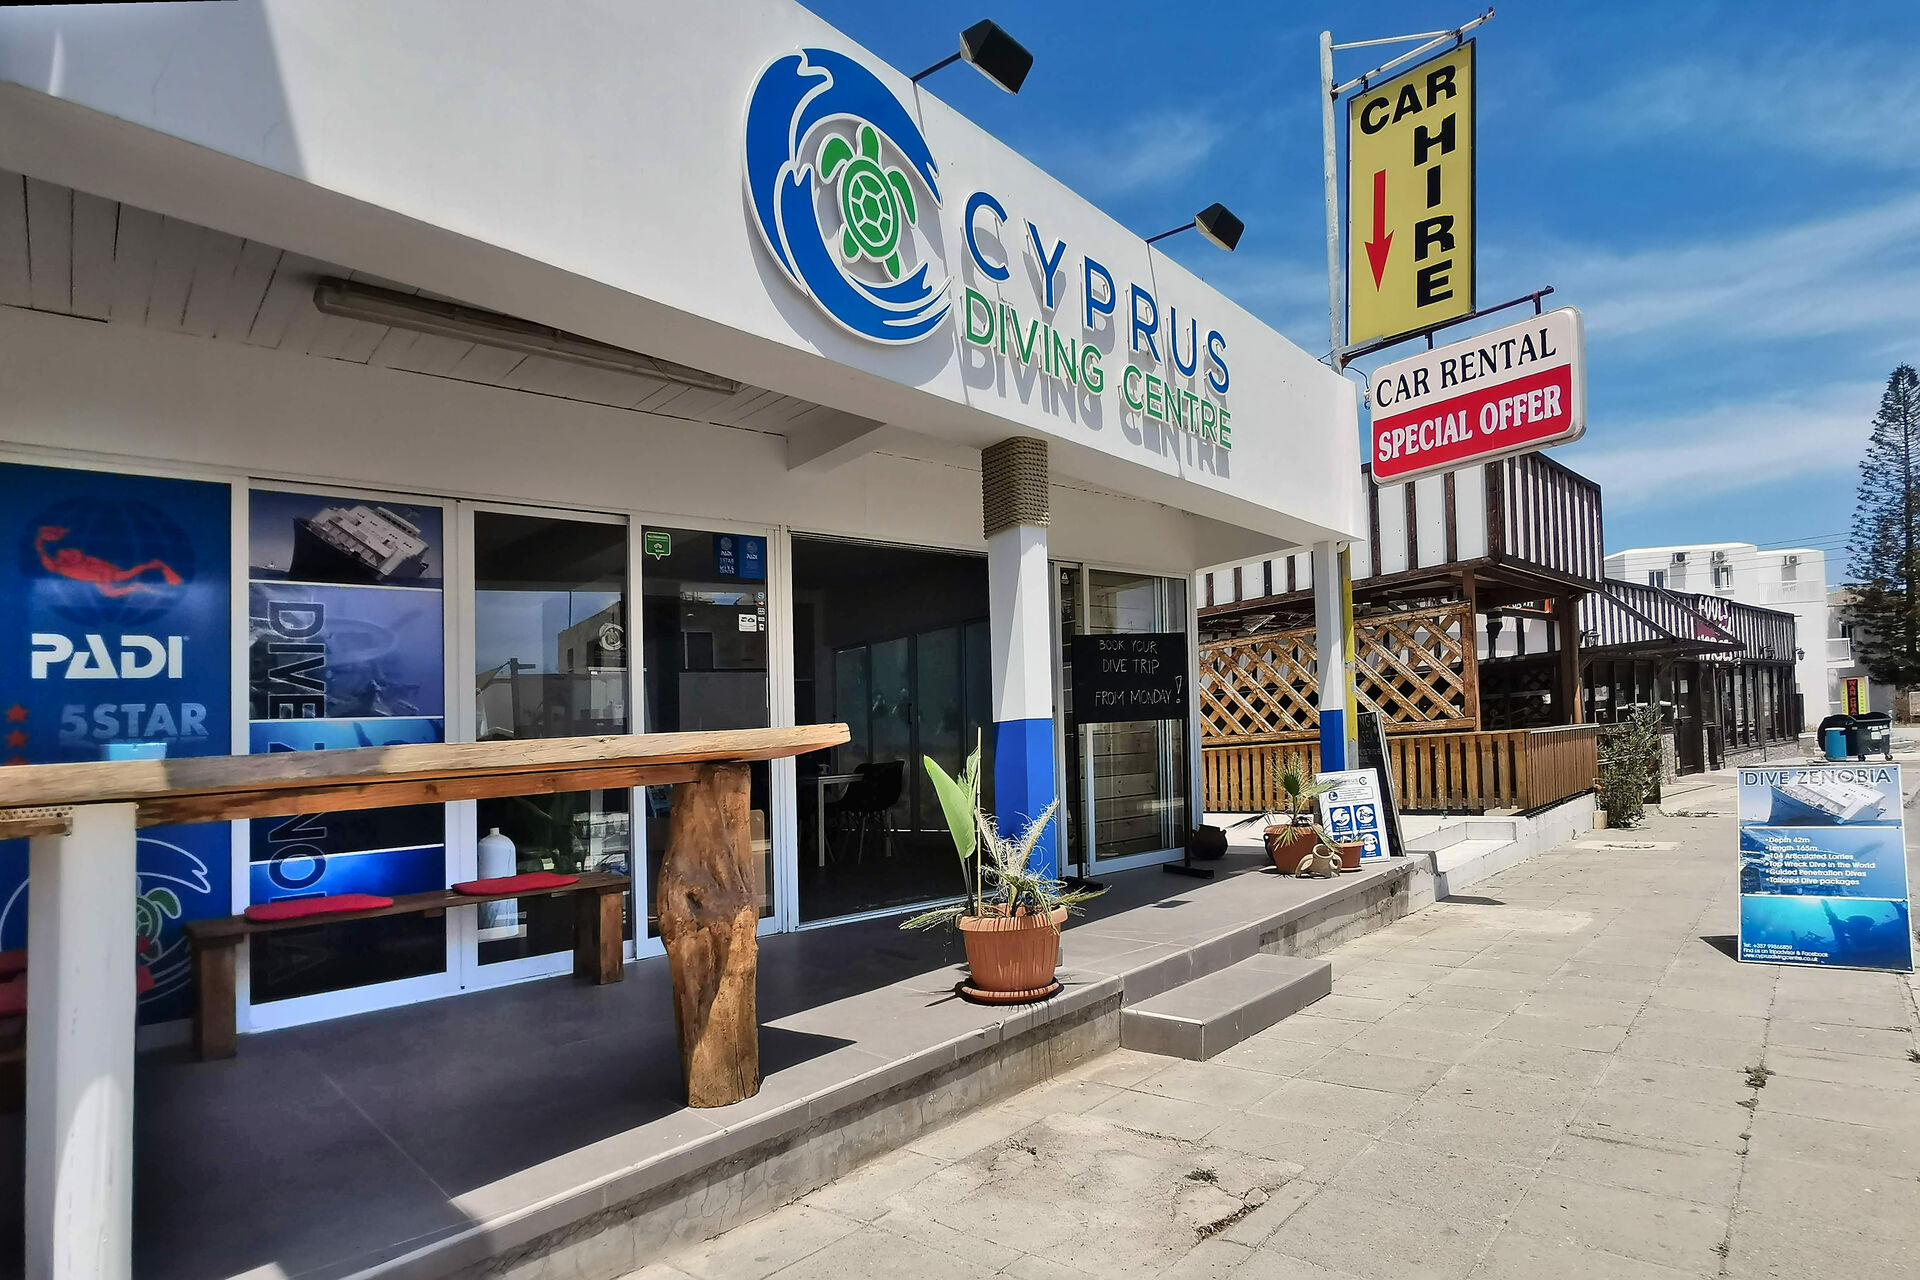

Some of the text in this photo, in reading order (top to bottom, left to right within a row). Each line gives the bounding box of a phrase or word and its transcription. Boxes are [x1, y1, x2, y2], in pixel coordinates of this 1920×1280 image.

[1360, 64, 1457, 136] CAR
[1413, 111, 1457, 309] HIRE
[962, 190, 1231, 396] CYPRUS
[964, 286, 1105, 396] DIVING
[1376, 327, 1558, 409] CAR RENTAL
[1121, 364, 1233, 450] CENTRE
[1377, 383, 1562, 463] SPECIAL OFFER
[1698, 596, 1730, 622] FOOLS
[31, 633, 183, 679] PADI
[267, 600, 327, 720] DIVE
[1098, 639, 1158, 655] BOOK YOUR
[1102, 658, 1160, 675] DIVE TRIP
[1095, 690, 1125, 707] FROM
[1744, 769, 1892, 786] DIVE ZENOBIA
[1820, 878, 1860, 886] packages
